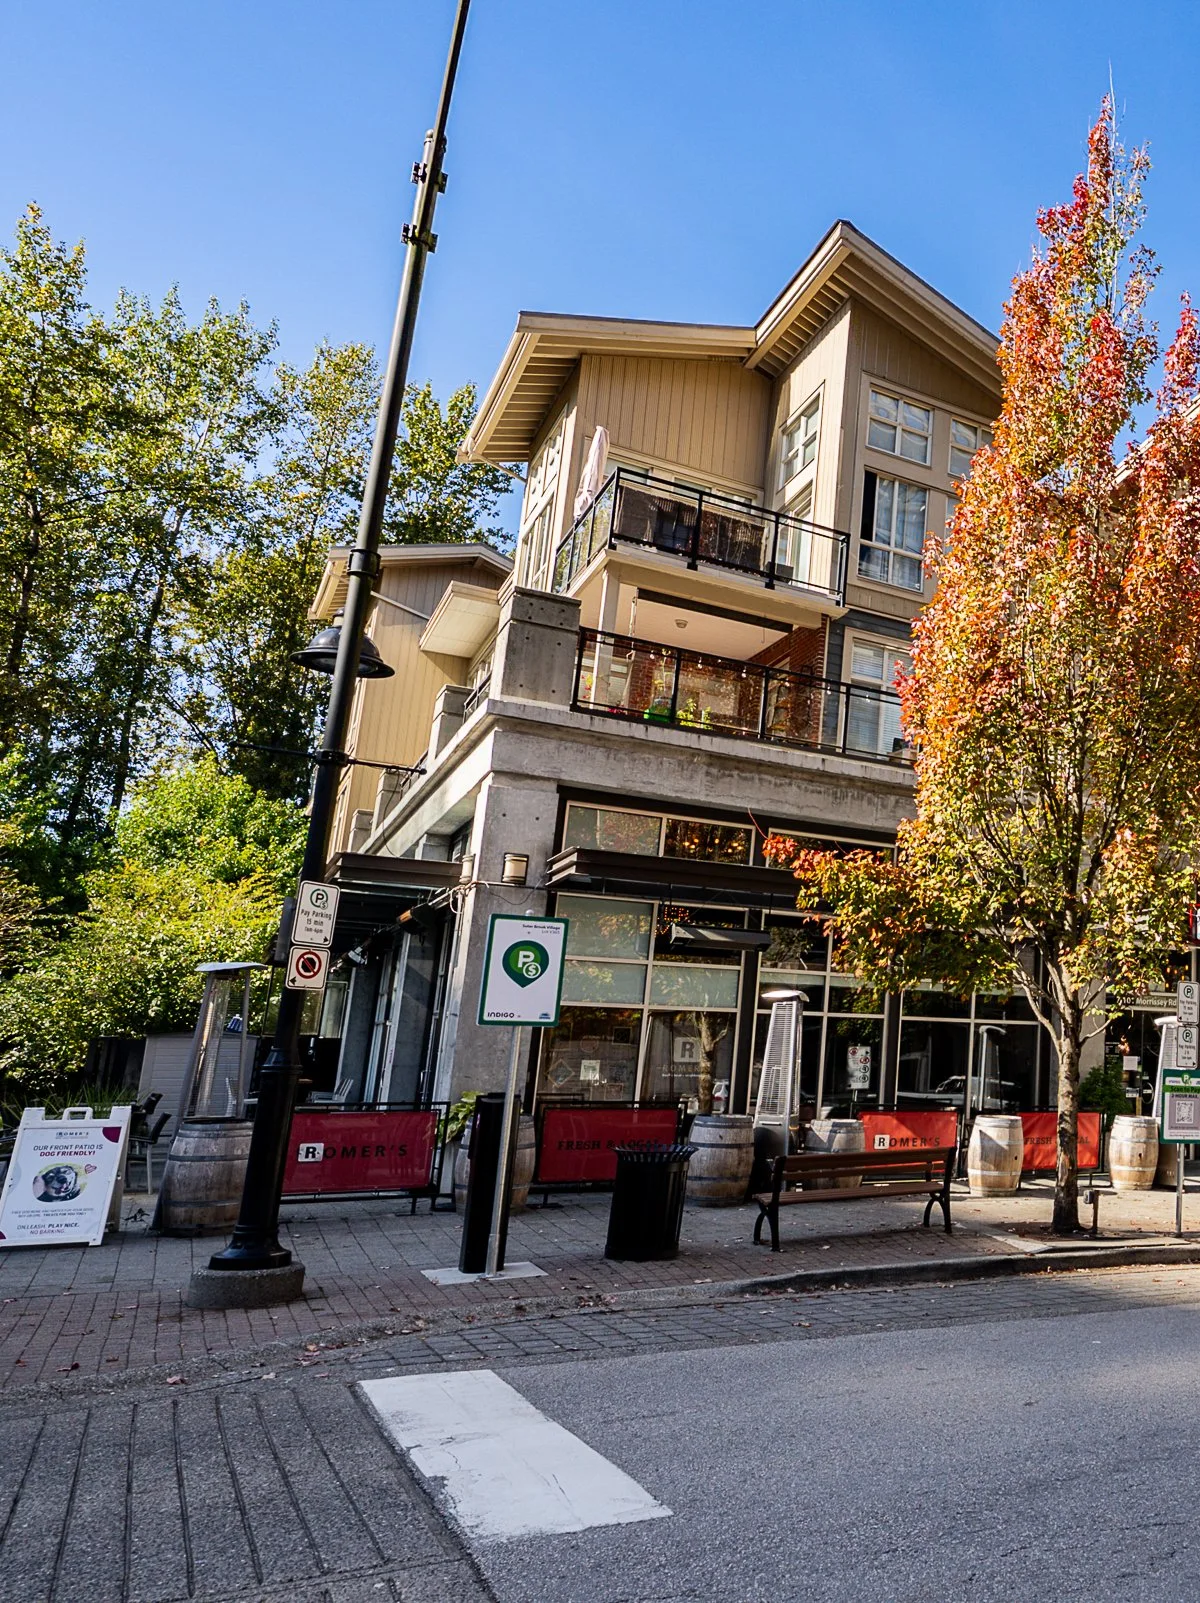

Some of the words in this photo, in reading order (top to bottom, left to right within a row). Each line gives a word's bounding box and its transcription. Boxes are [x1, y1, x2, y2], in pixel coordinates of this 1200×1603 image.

[301, 909, 310, 917] Pay
[312, 910, 332, 920] Parking
[1136, 997, 1168, 1007] Morrissey
[487, 1011, 515, 1019] INDIGO
[558, 1140, 601, 1150] FRESH
[877, 1136, 940, 1148] ROMER'S
[303, 1144, 408, 1159] ROMER'S
